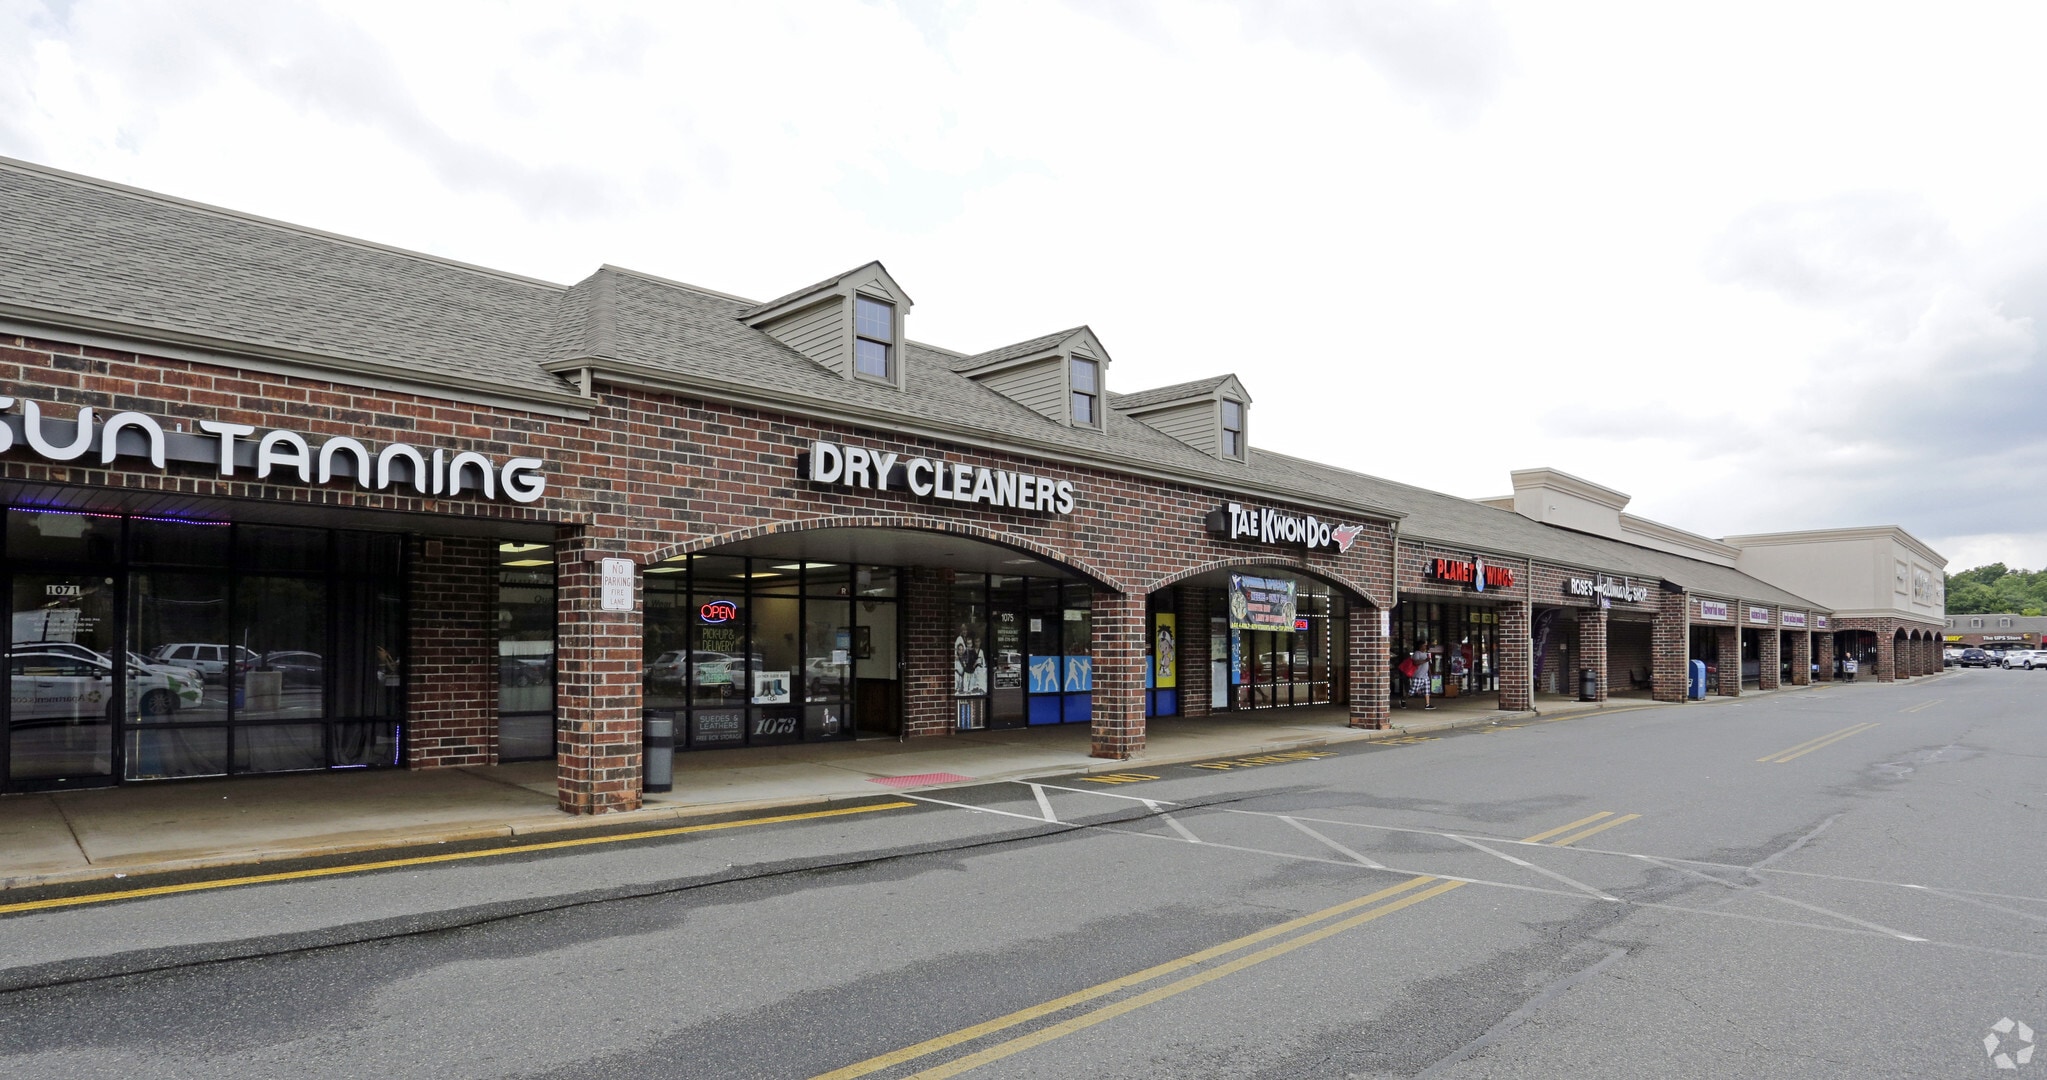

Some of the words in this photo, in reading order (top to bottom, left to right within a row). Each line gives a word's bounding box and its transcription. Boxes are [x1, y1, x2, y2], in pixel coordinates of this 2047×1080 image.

[0, 396, 165, 469] UN
[200, 420, 546, 503] TANNING
[810, 441, 898, 491] DRY
[906, 458, 1074, 515] CLEANERS
[612, 564, 623, 575] NO
[1437, 559, 1474, 583] PLANET
[1486, 565, 1514, 588] WINGS
[605, 577, 631, 587] PARKING
[48, 586, 78, 595] 1071
[1593, 572, 1633, 605] Hallmark
[1633, 587, 1647, 602] SHOP
[610, 598, 625, 606] LANE
[701, 604, 735, 619] OPEN
[1001, 613, 1014, 622] 1075
[702, 640, 735, 652] DELIVERY
[700, 715, 730, 723] SUEDES
[700, 721, 739, 730] LEATHERS
[753, 716, 796, 735] 1073
[720, 733, 742, 741] STORAGE
